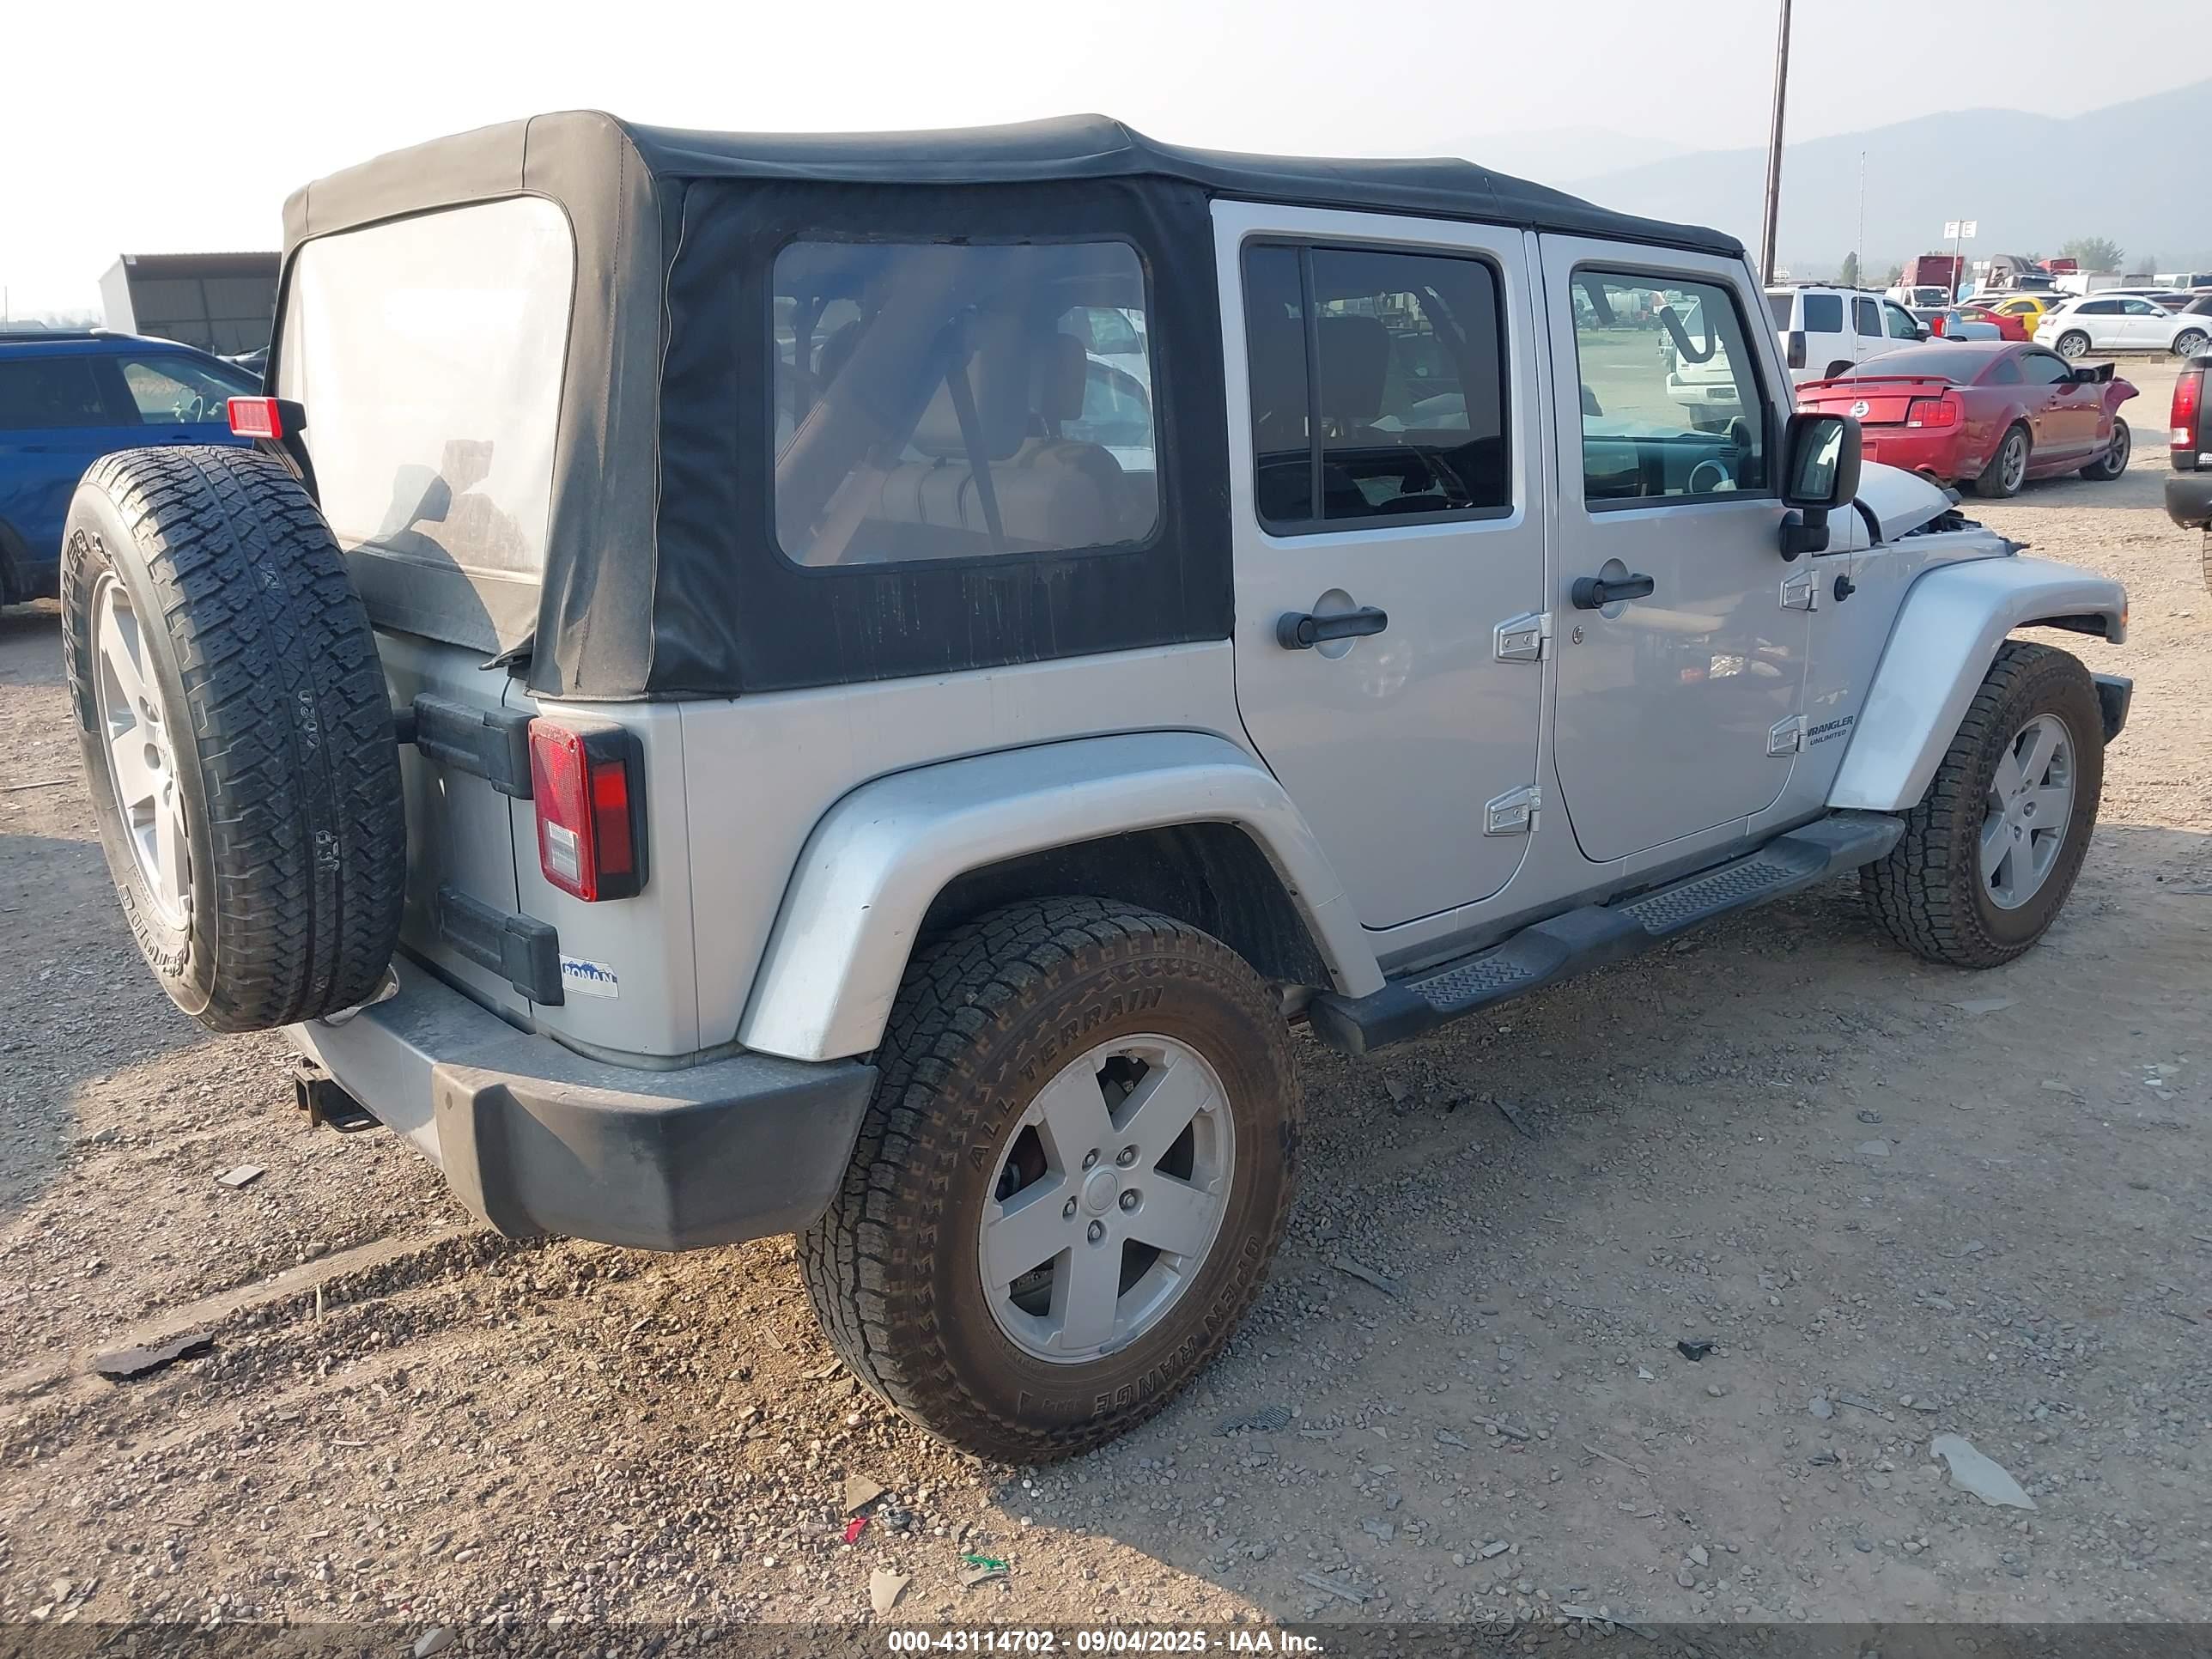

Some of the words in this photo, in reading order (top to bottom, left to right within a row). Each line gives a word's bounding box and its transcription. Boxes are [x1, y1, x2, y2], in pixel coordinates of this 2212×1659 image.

[1964, 222, 1972, 235] E
[1809, 729, 1847, 745] UNLIMITED
[969, 1097, 1017, 1172] ALL
[1019, 986, 1164, 1080] TERRAIN
[1204, 1236, 1261, 1335] OPEN
[1092, 1334, 1198, 1418] RANGE
